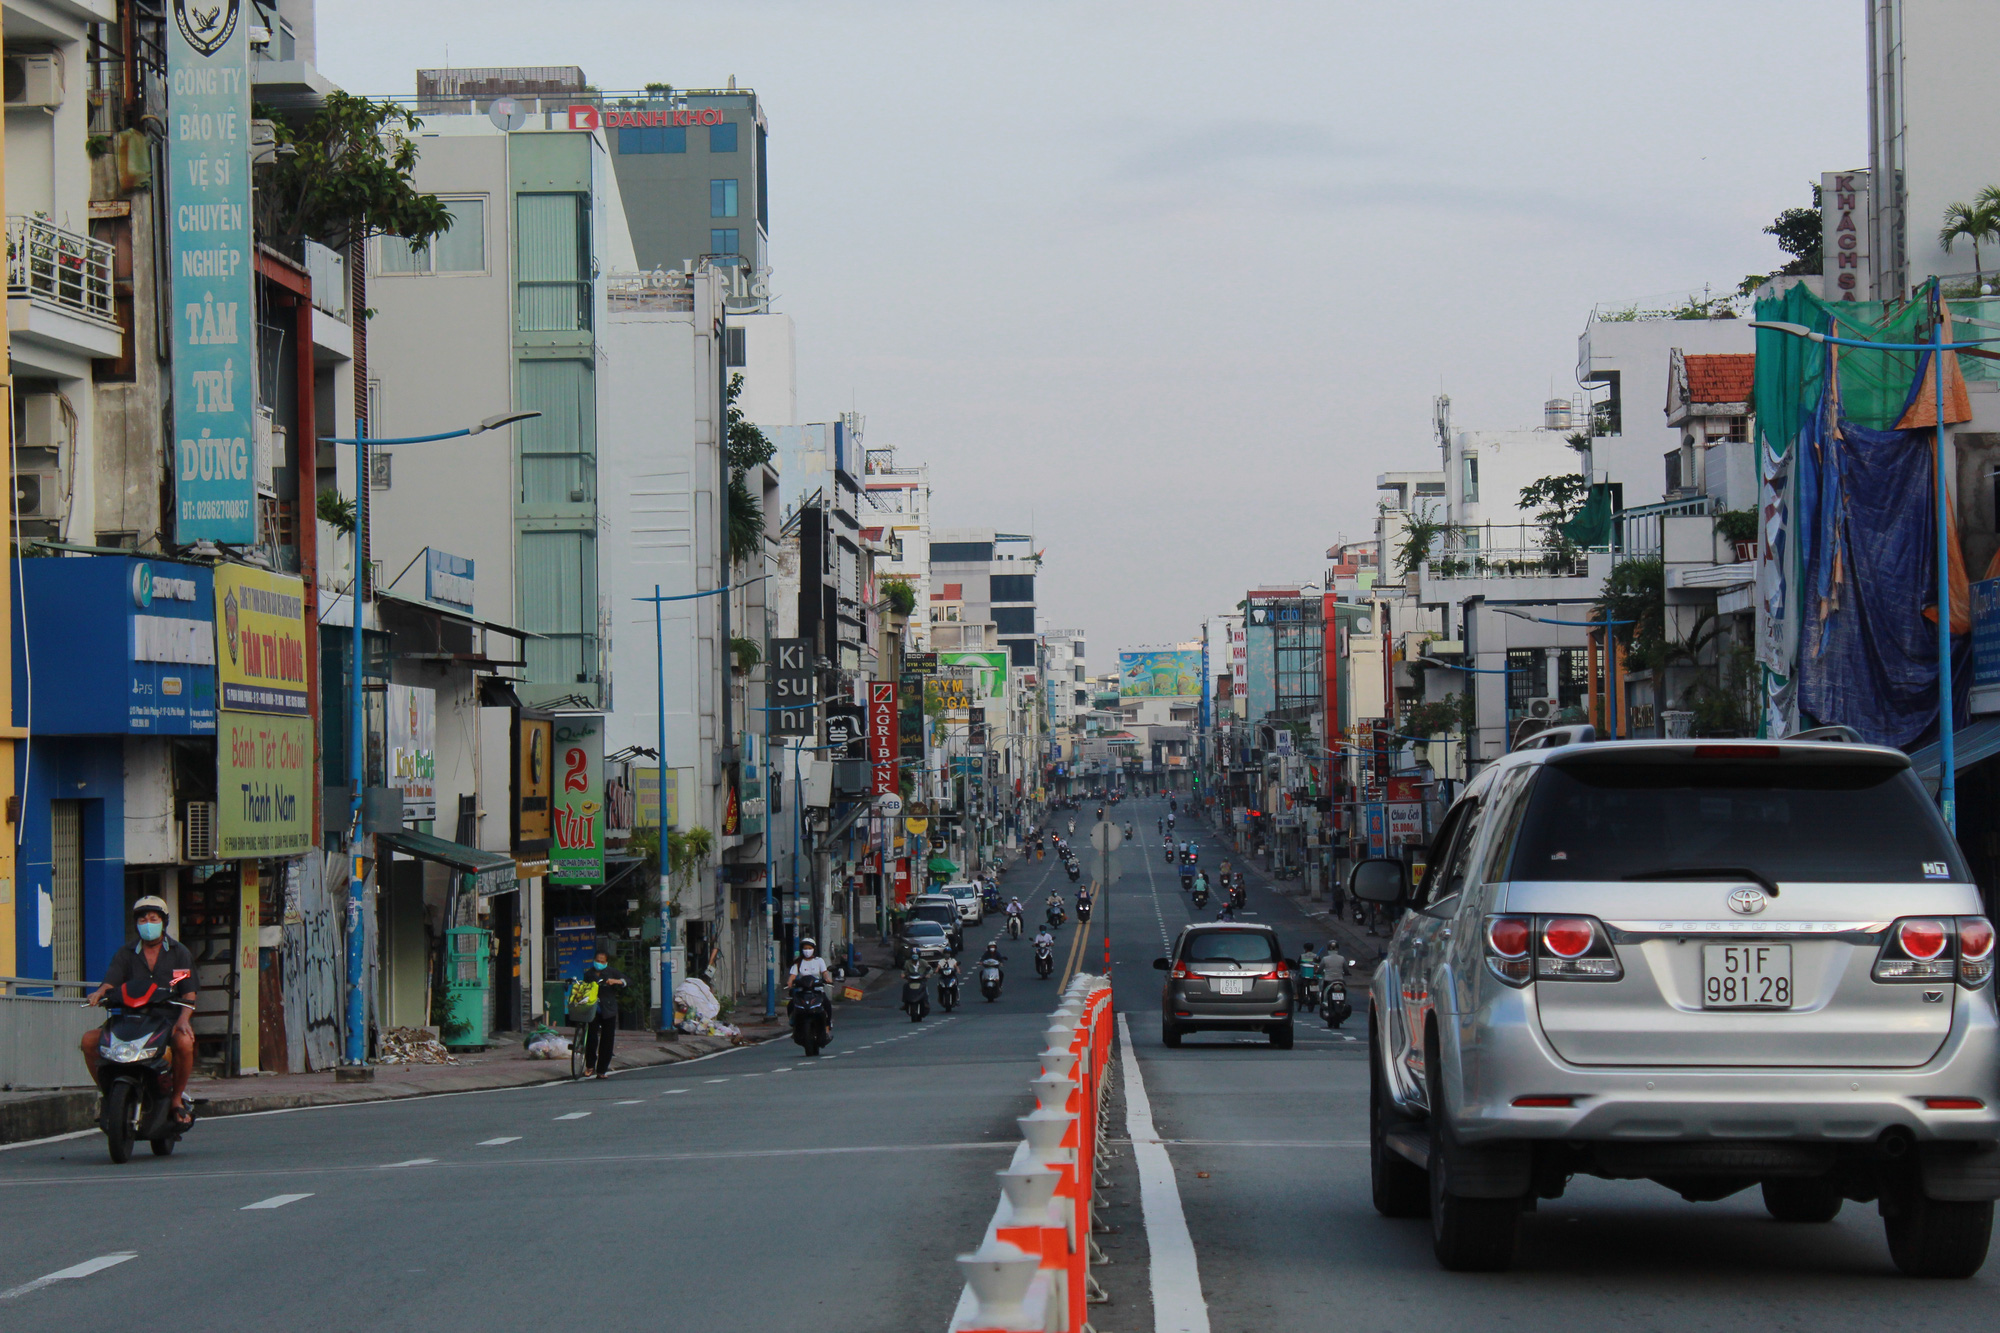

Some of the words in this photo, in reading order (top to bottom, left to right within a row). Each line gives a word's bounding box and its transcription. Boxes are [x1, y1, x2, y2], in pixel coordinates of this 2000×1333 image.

[174, 63, 216, 96] CÔNG
[221, 68, 242, 95] TY
[180, 104, 212, 140] BẢO
[216, 106, 237, 144] VỆ
[605, 111, 668, 127] DANH
[672, 106, 723, 126] KHÔI
[188, 152, 208, 191] VỆ
[214, 152, 230, 186] SĨ
[178, 197, 242, 232] CHUYÊN
[1835, 176, 1858, 268] KHÁCH
[182, 242, 240, 282] NGHIỆP
[186, 290, 238, 345] TÂM
[192, 358, 234, 413] TRÍ
[181, 428, 248, 482] DŨNG
[182, 501, 195, 520] ĐT:
[197, 500, 249, 519] 02862700837
[241, 624, 262, 678] TÂM
[262, 630, 278, 680] TRÍ
[279, 632, 303, 683] DŨNG
[1233, 647, 1246, 659] KHOA
[1234, 631, 1244, 642] NHA
[779, 646, 804, 670] Ki
[777, 678, 808, 696] su
[929, 680, 964, 693] GYM
[780, 704, 804, 729] hi
[232, 726, 255, 769] Bánh
[259, 728, 276, 769] Tét
[281, 726, 304, 769] Chuối
[876, 704, 891, 793] AGRIBANK
[565, 748, 588, 794] 2
[241, 781, 270, 822] Thành
[275, 784, 296, 822] Nam
[881, 801, 900, 809] ACB
[554, 802, 595, 850] Vui
[1658, 922, 1838, 931] FORTUNER
[1725, 948, 1770, 974] 51F
[1707, 977, 1789, 1002] 981.28
